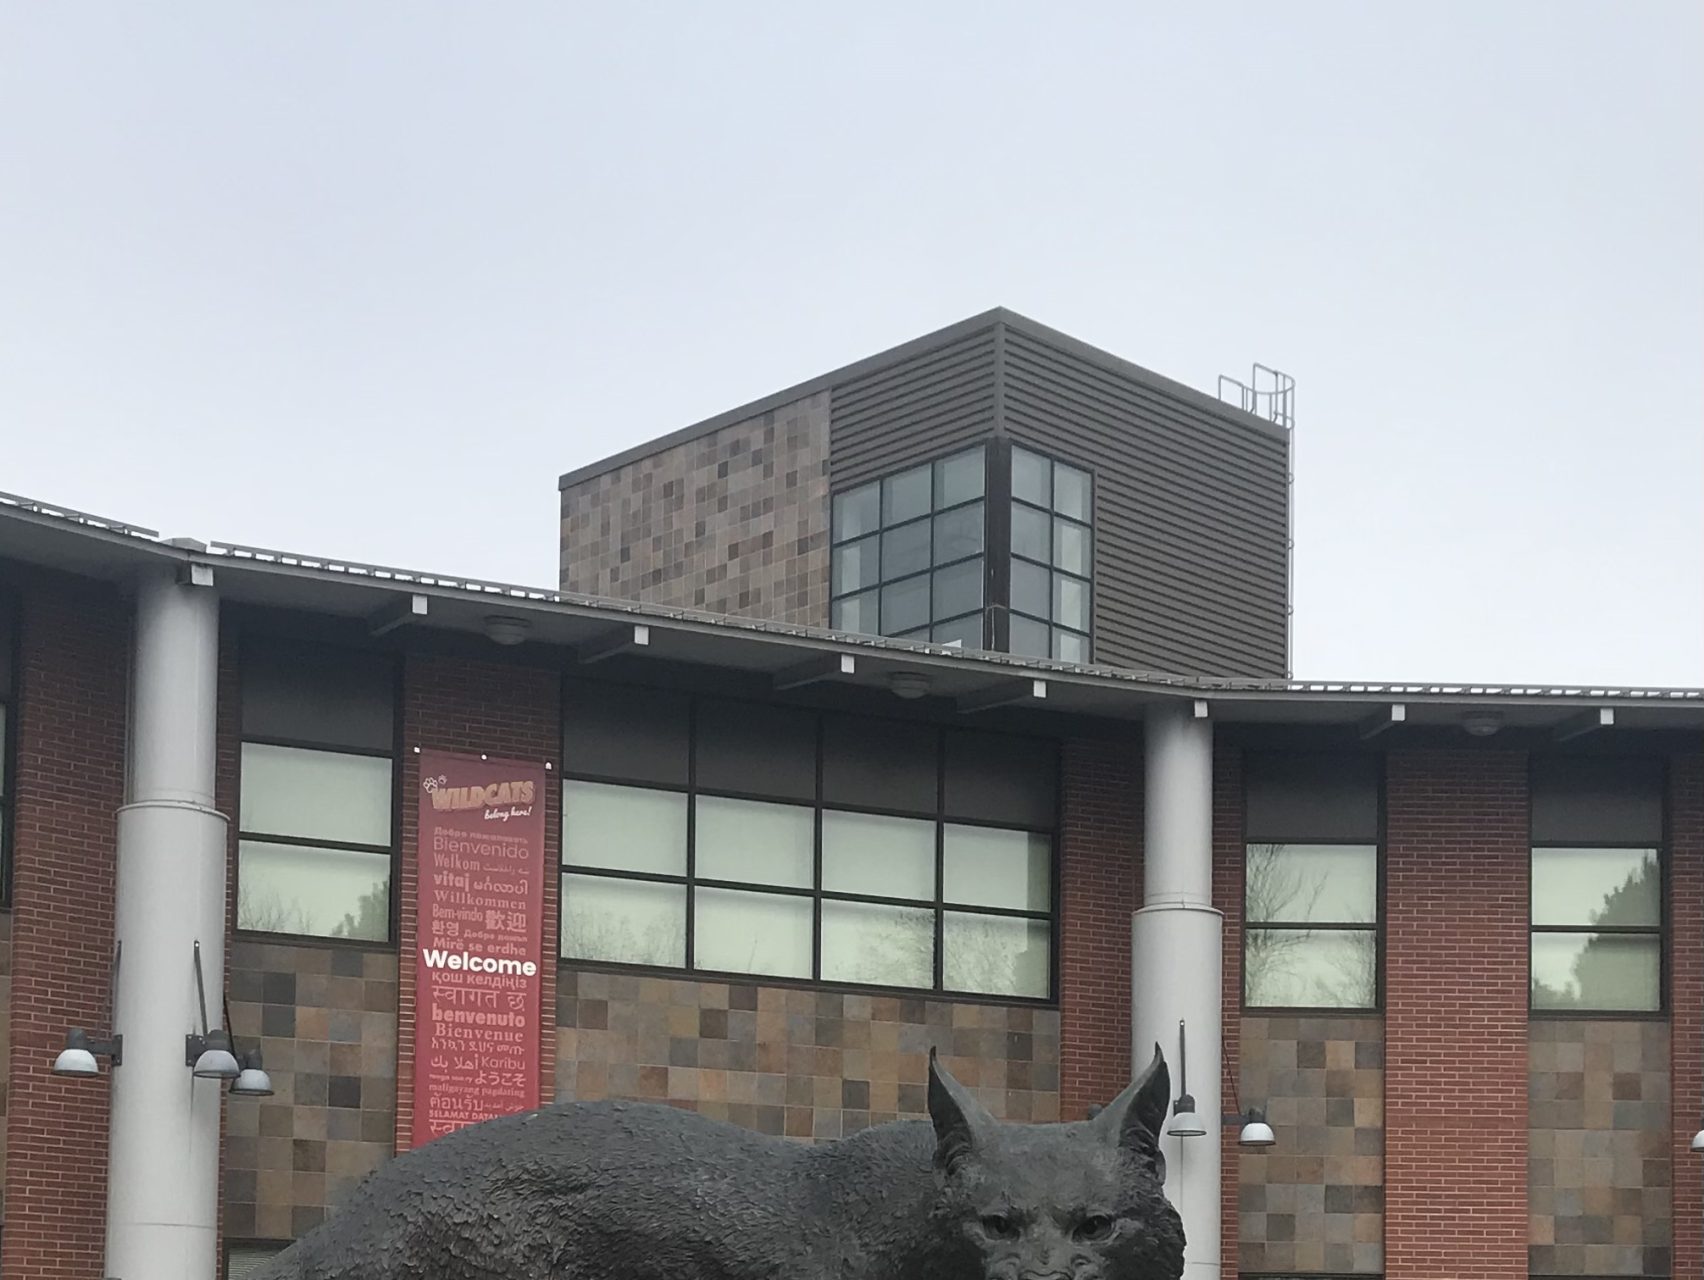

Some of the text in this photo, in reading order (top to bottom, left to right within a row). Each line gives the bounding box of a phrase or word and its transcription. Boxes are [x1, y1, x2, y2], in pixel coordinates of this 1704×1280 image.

[431, 780, 535, 811] WILDCATS
[484, 805, 532, 822] belong here!
[433, 836, 529, 860] Bienvenido
[433, 851, 480, 871] Welkom
[433, 870, 470, 892] vitaj
[433, 889, 527, 910] Willkommen
[432, 903, 483, 922] Bem-vindo
[431, 919, 459, 937] 환영
[468, 942, 483, 953] se
[487, 941, 527, 956] erdhe
[422, 947, 537, 977] Welcome
[431, 985, 500, 1009] स्वागत
[431, 1002, 525, 1028] benvenuto
[435, 1022, 524, 1043] Bienvenue
[481, 1056, 525, 1070] Karibu
[474, 1070, 527, 1087] ようこそ
[429, 1108, 499, 1121] SELAMAT DATA
